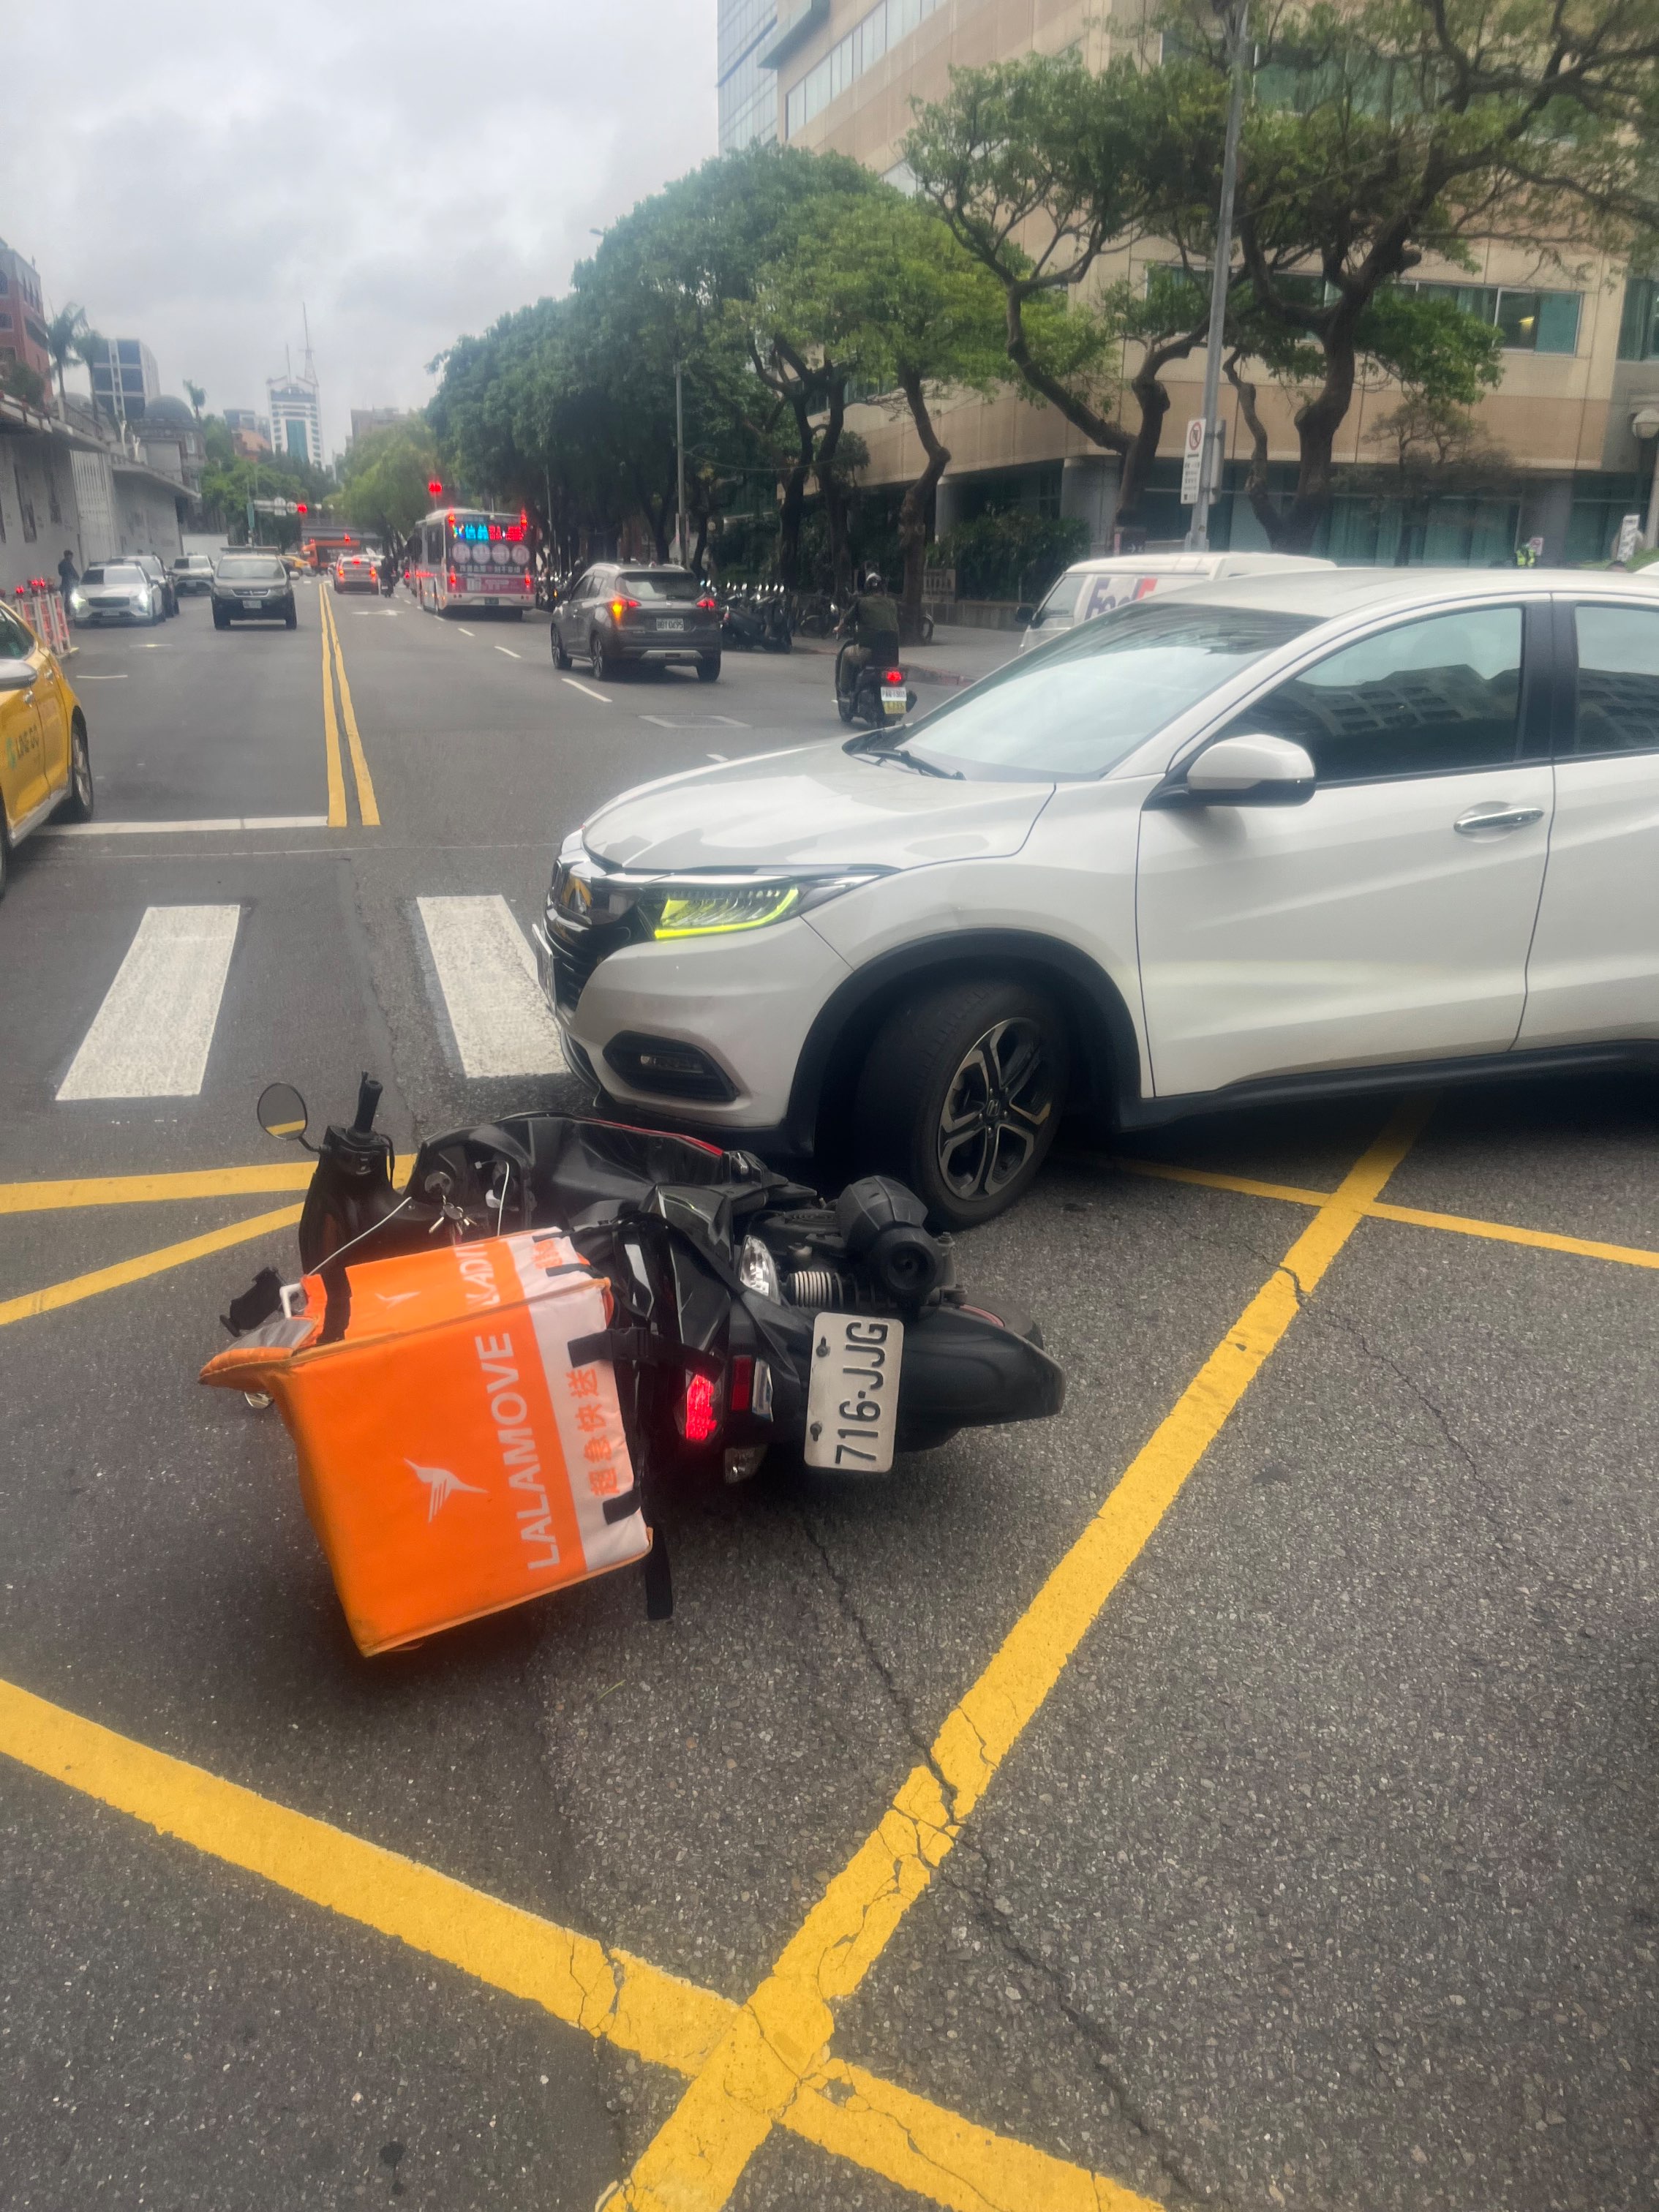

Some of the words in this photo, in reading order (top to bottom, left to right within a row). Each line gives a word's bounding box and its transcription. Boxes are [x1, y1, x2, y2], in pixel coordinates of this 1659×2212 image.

[474, 1332, 560, 1570] LALAMOVE
[566, 1368, 620, 1496] 超急快送
